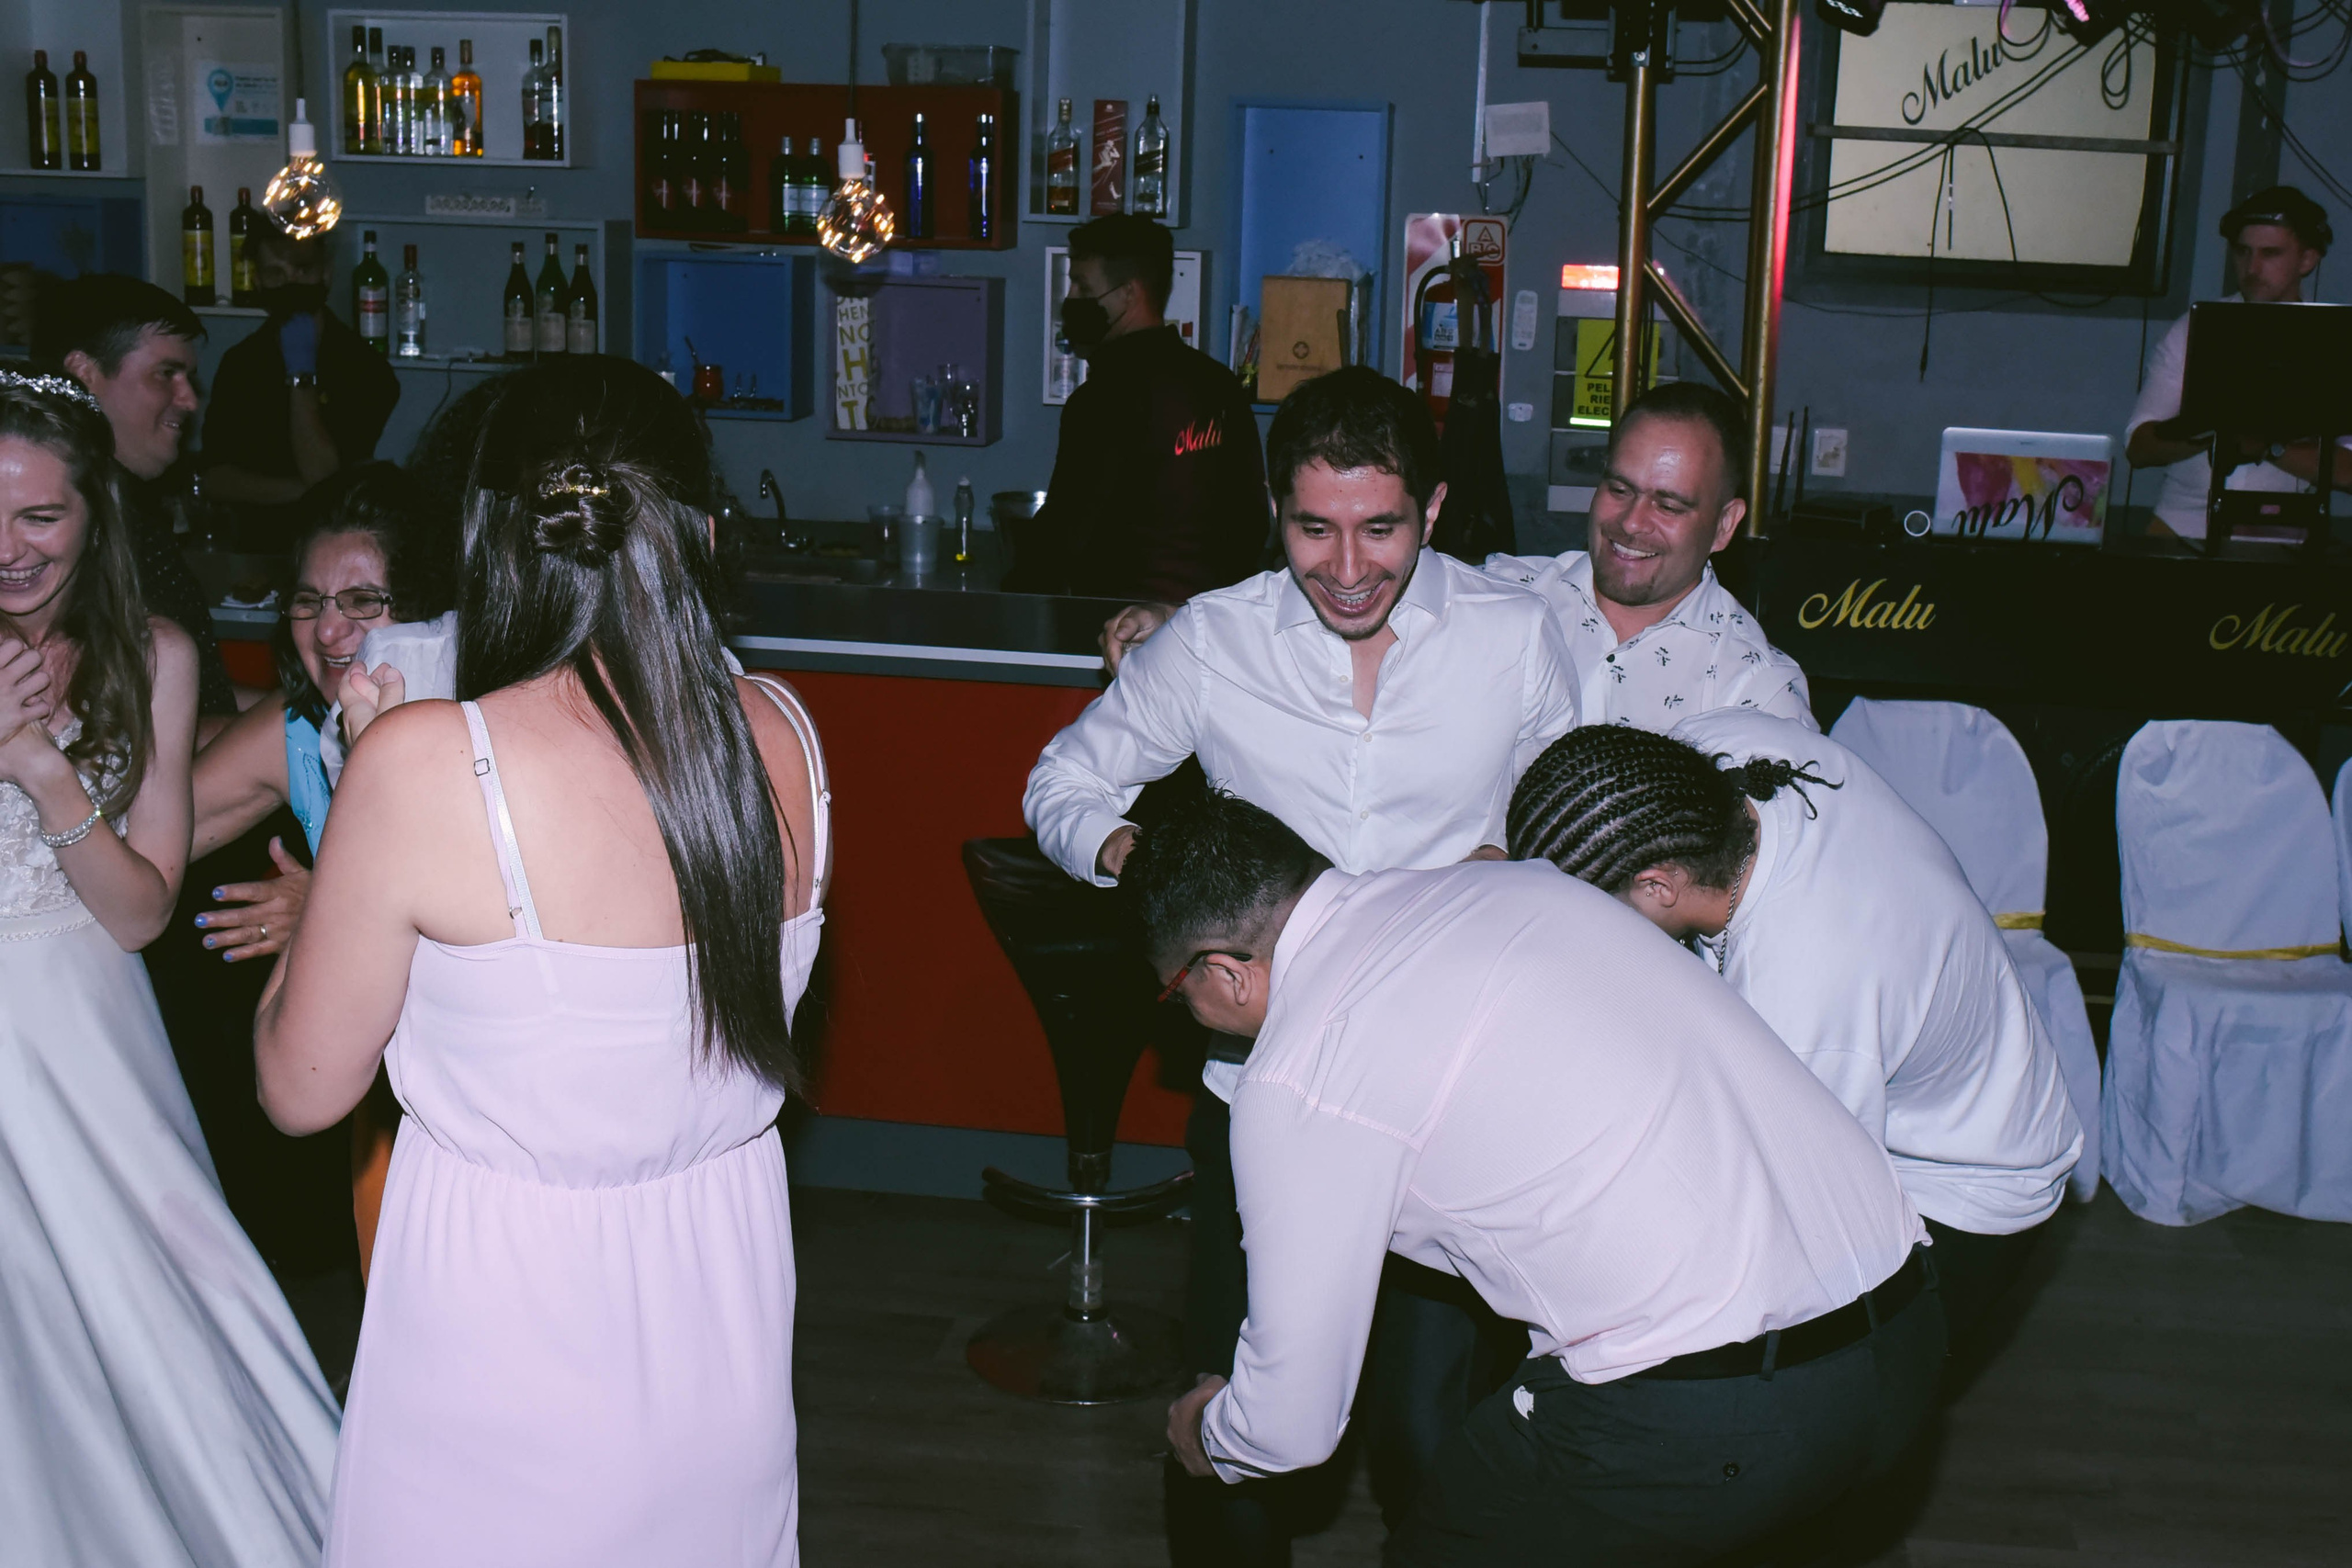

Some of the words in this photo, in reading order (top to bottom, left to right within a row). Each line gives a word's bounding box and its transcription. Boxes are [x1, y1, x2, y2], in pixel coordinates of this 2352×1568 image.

[1901, 35, 2003, 125] Malu
[1589, 394, 1610, 404] RIE
[1174, 416, 1222, 456] Malu
[1951, 474, 2085, 542] Malu
[1797, 578, 1937, 630] Malu
[2209, 602, 2348, 658] Malu
